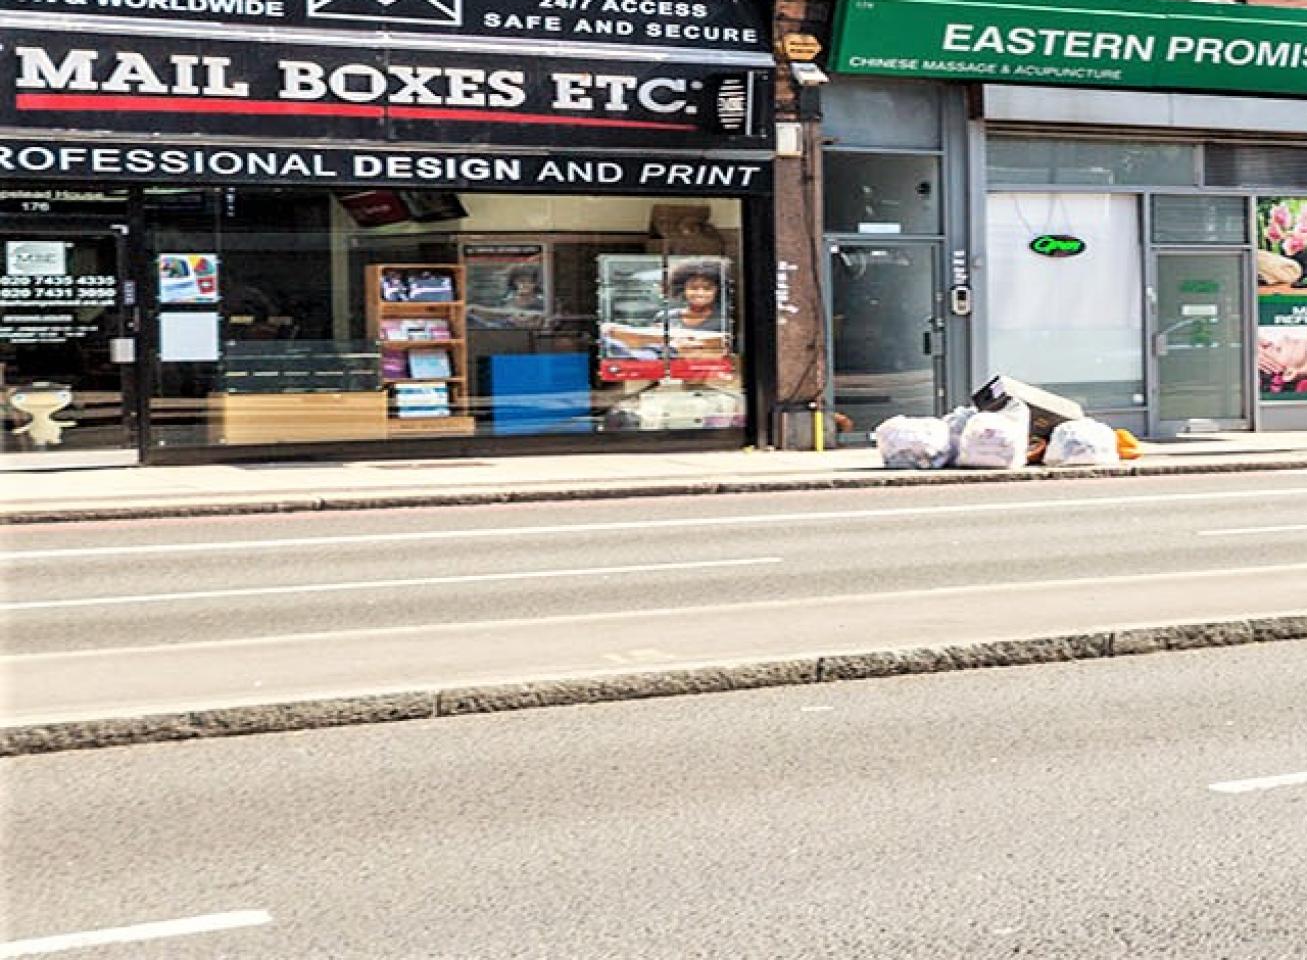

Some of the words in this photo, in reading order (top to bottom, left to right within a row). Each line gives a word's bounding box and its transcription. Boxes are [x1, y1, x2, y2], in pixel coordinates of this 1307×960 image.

[483, 13, 561, 31] SAFE
[573, 18, 634, 35] AND
[646, 24, 758, 43] SECURE
[942, 23, 1154, 62] EASTERN
[15, 45, 249, 97] MAIL
[277, 59, 527, 108] BOXES
[849, 55, 919, 71] CHINESE
[922, 60, 997, 75] MASSAGE
[1001, 63, 1011, 75] &
[1013, 64, 1123, 81] ACUPUNCTURE
[0, 145, 337, 178] ROFESSIONAL
[354, 155, 521, 181] DESIGN
[538, 160, 623, 184] AND
[639, 163, 761, 187] PRINT
[1034, 237, 1080, 254] Open
